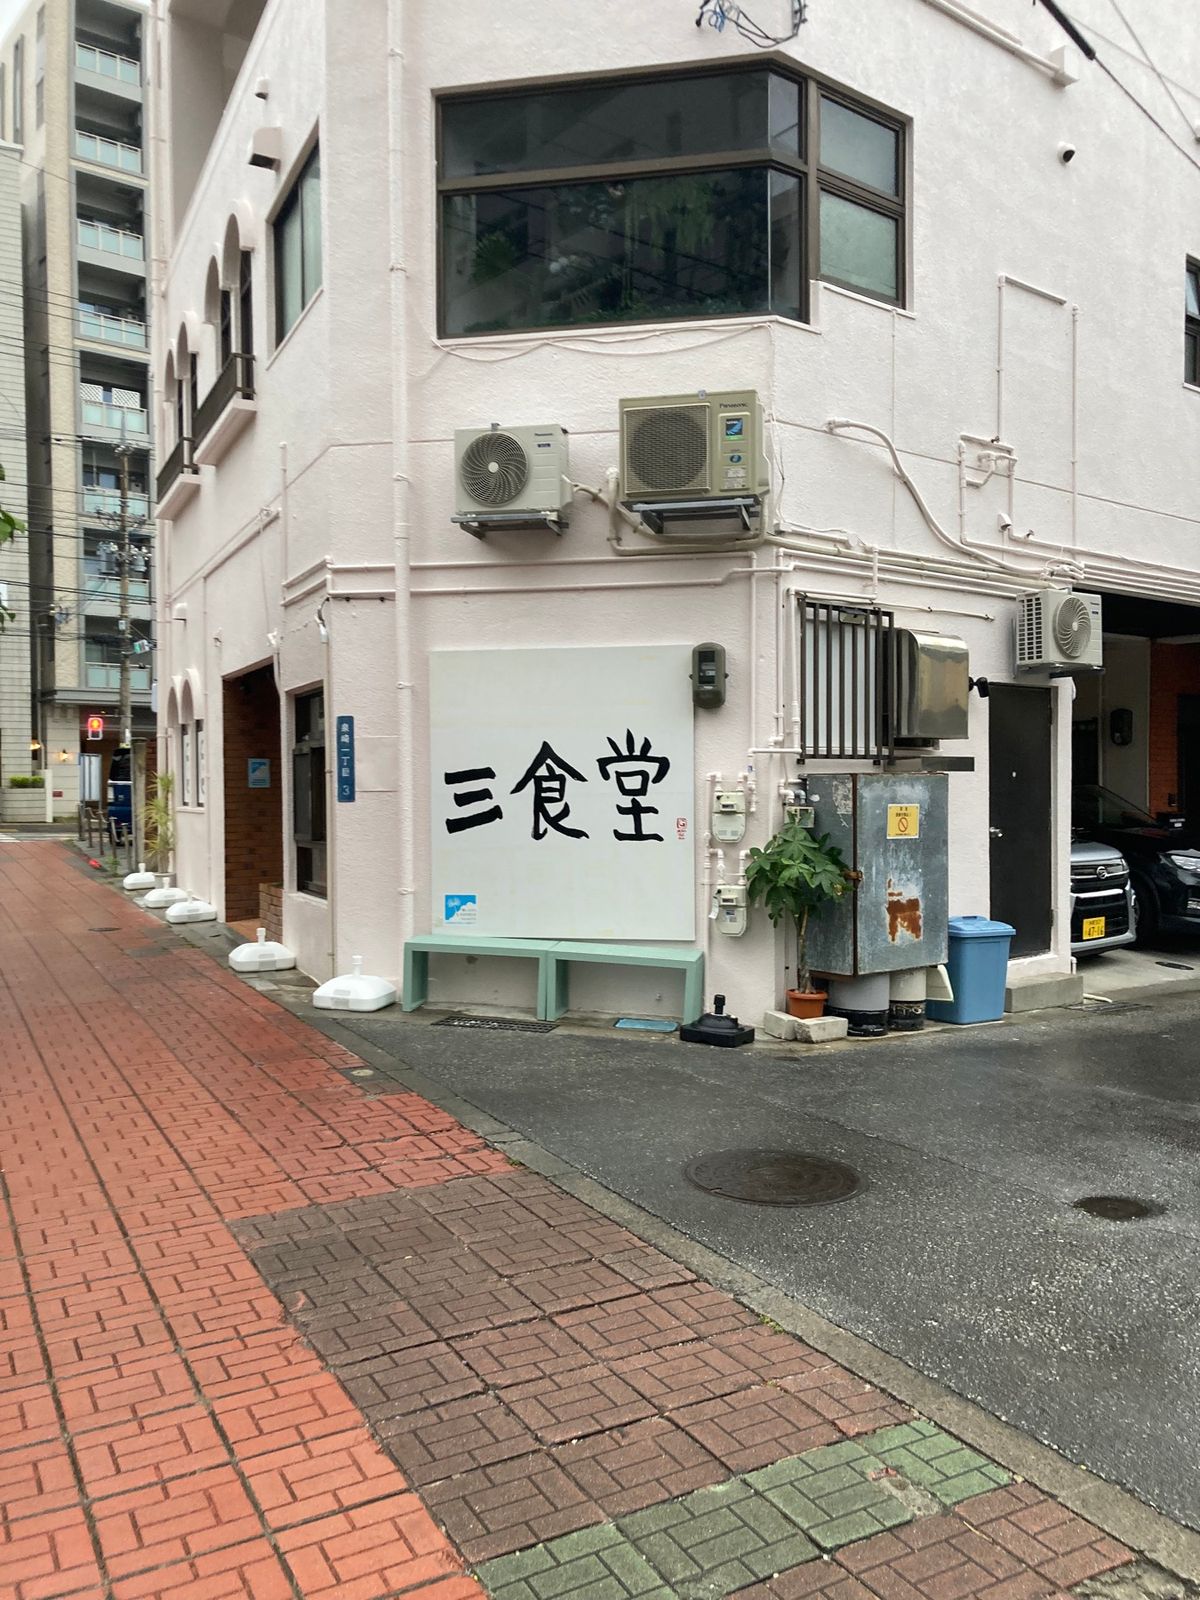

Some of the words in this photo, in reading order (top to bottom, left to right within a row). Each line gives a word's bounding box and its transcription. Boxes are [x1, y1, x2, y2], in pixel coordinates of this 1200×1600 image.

[342, 785, 350, 796] 3
[444, 728, 670, 842] 三食堂
